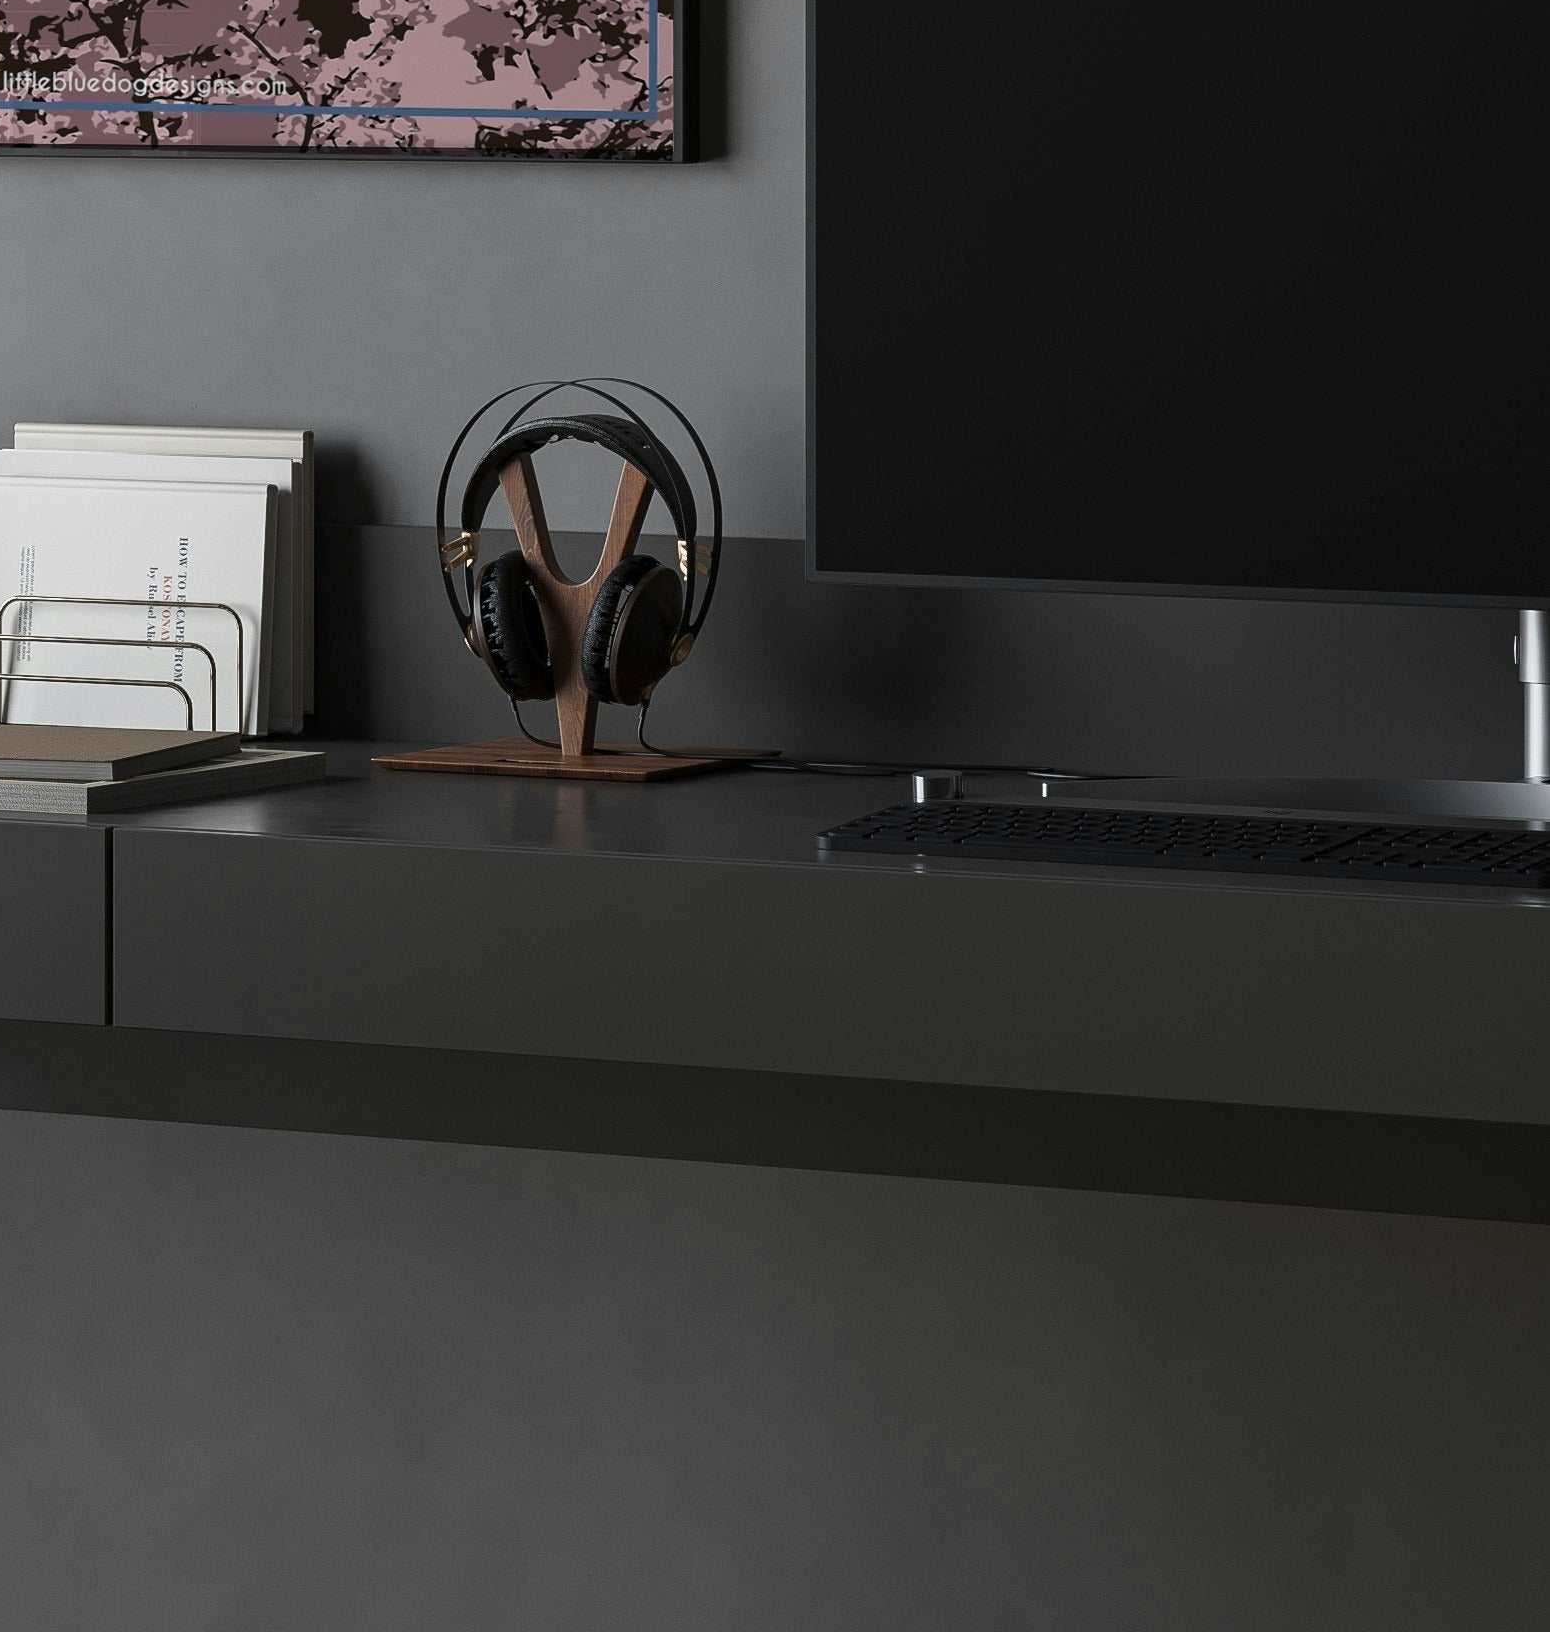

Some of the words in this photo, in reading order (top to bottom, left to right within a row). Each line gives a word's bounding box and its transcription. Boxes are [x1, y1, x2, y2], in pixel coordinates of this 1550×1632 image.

[2, 70, 288, 98] littlebluedogdesigns.com
[178, 537, 189, 569] HOW
[147, 567, 159, 581] by
[177, 572, 188, 590] TO
[175, 594, 187, 643] ECAPE
